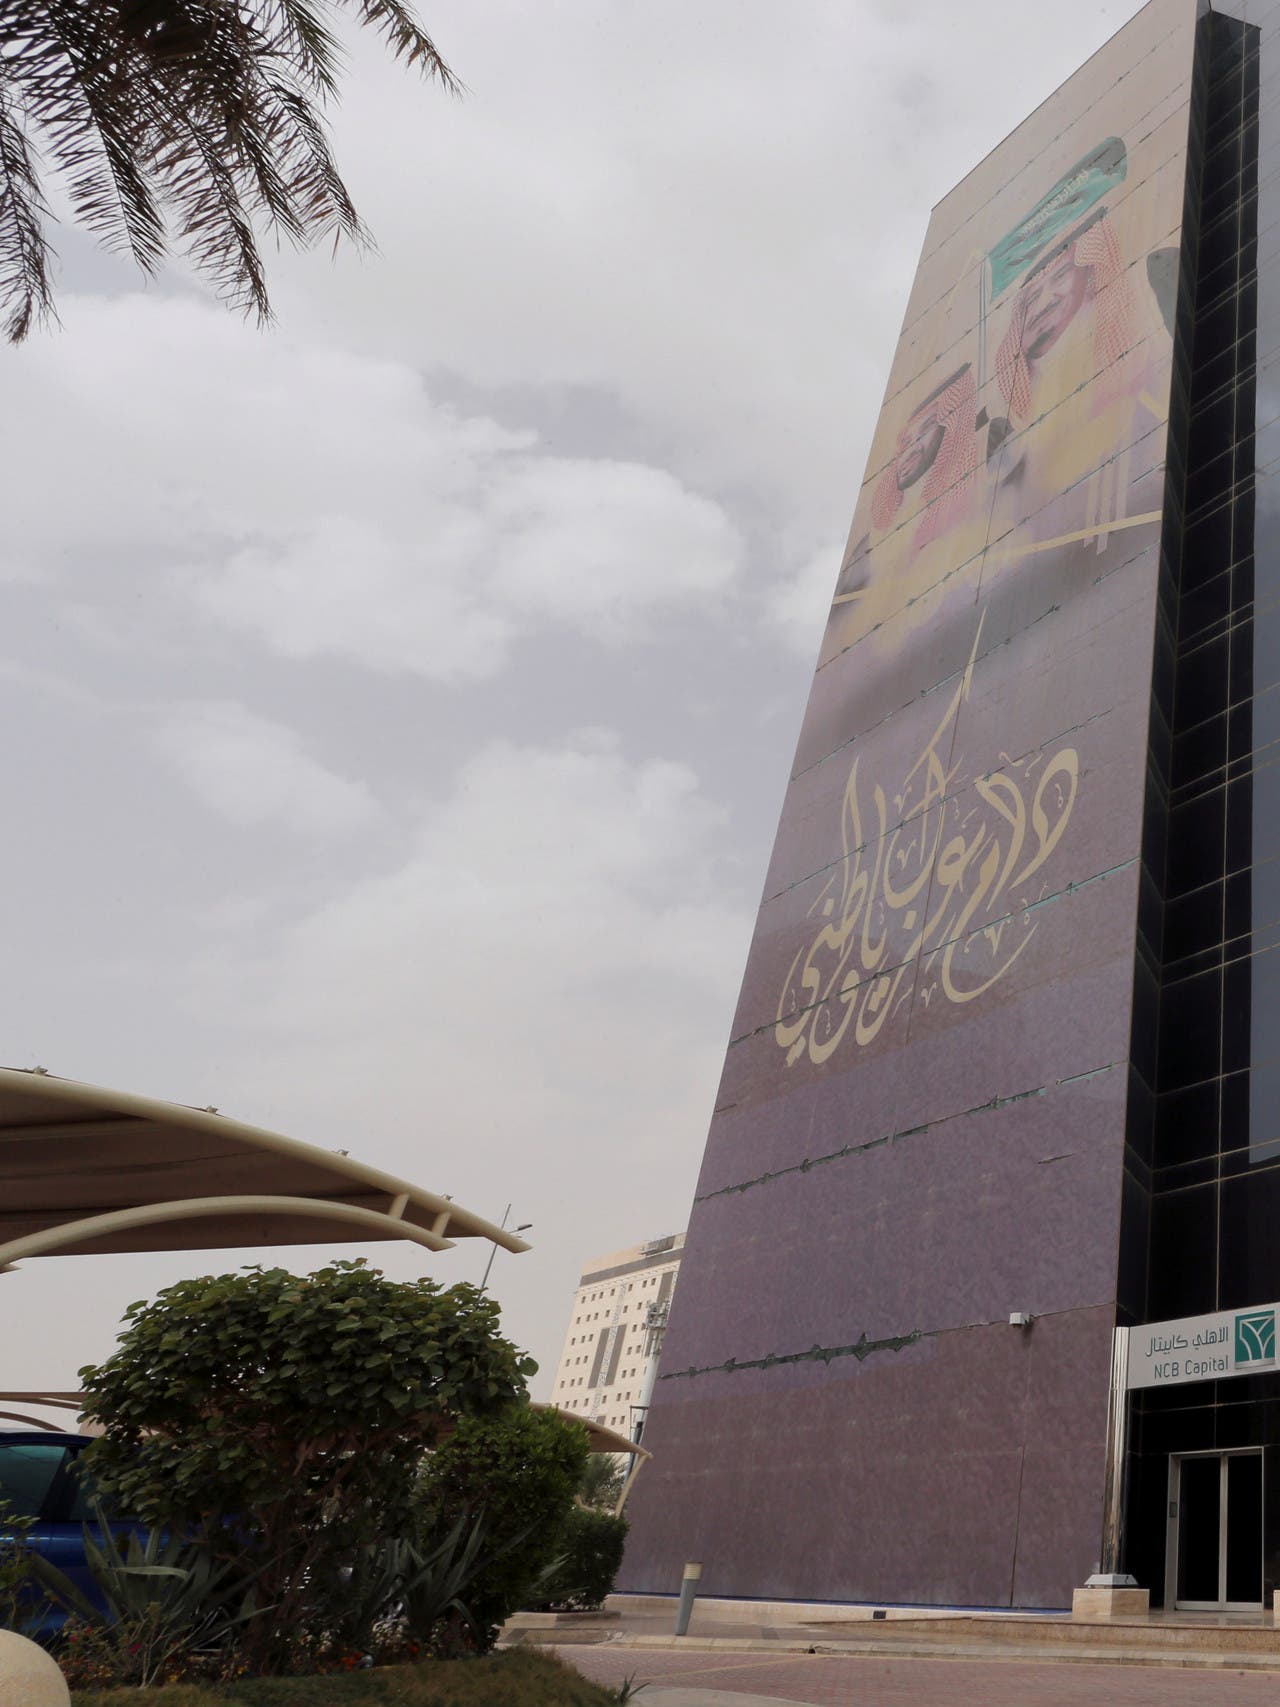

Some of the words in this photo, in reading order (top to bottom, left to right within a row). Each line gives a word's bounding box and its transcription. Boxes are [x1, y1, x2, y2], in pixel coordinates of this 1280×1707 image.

[1145, 1335, 1189, 1357] كابيتال
[1154, 1361, 1179, 1379] NCB
[1185, 1355, 1229, 1376] Capital
